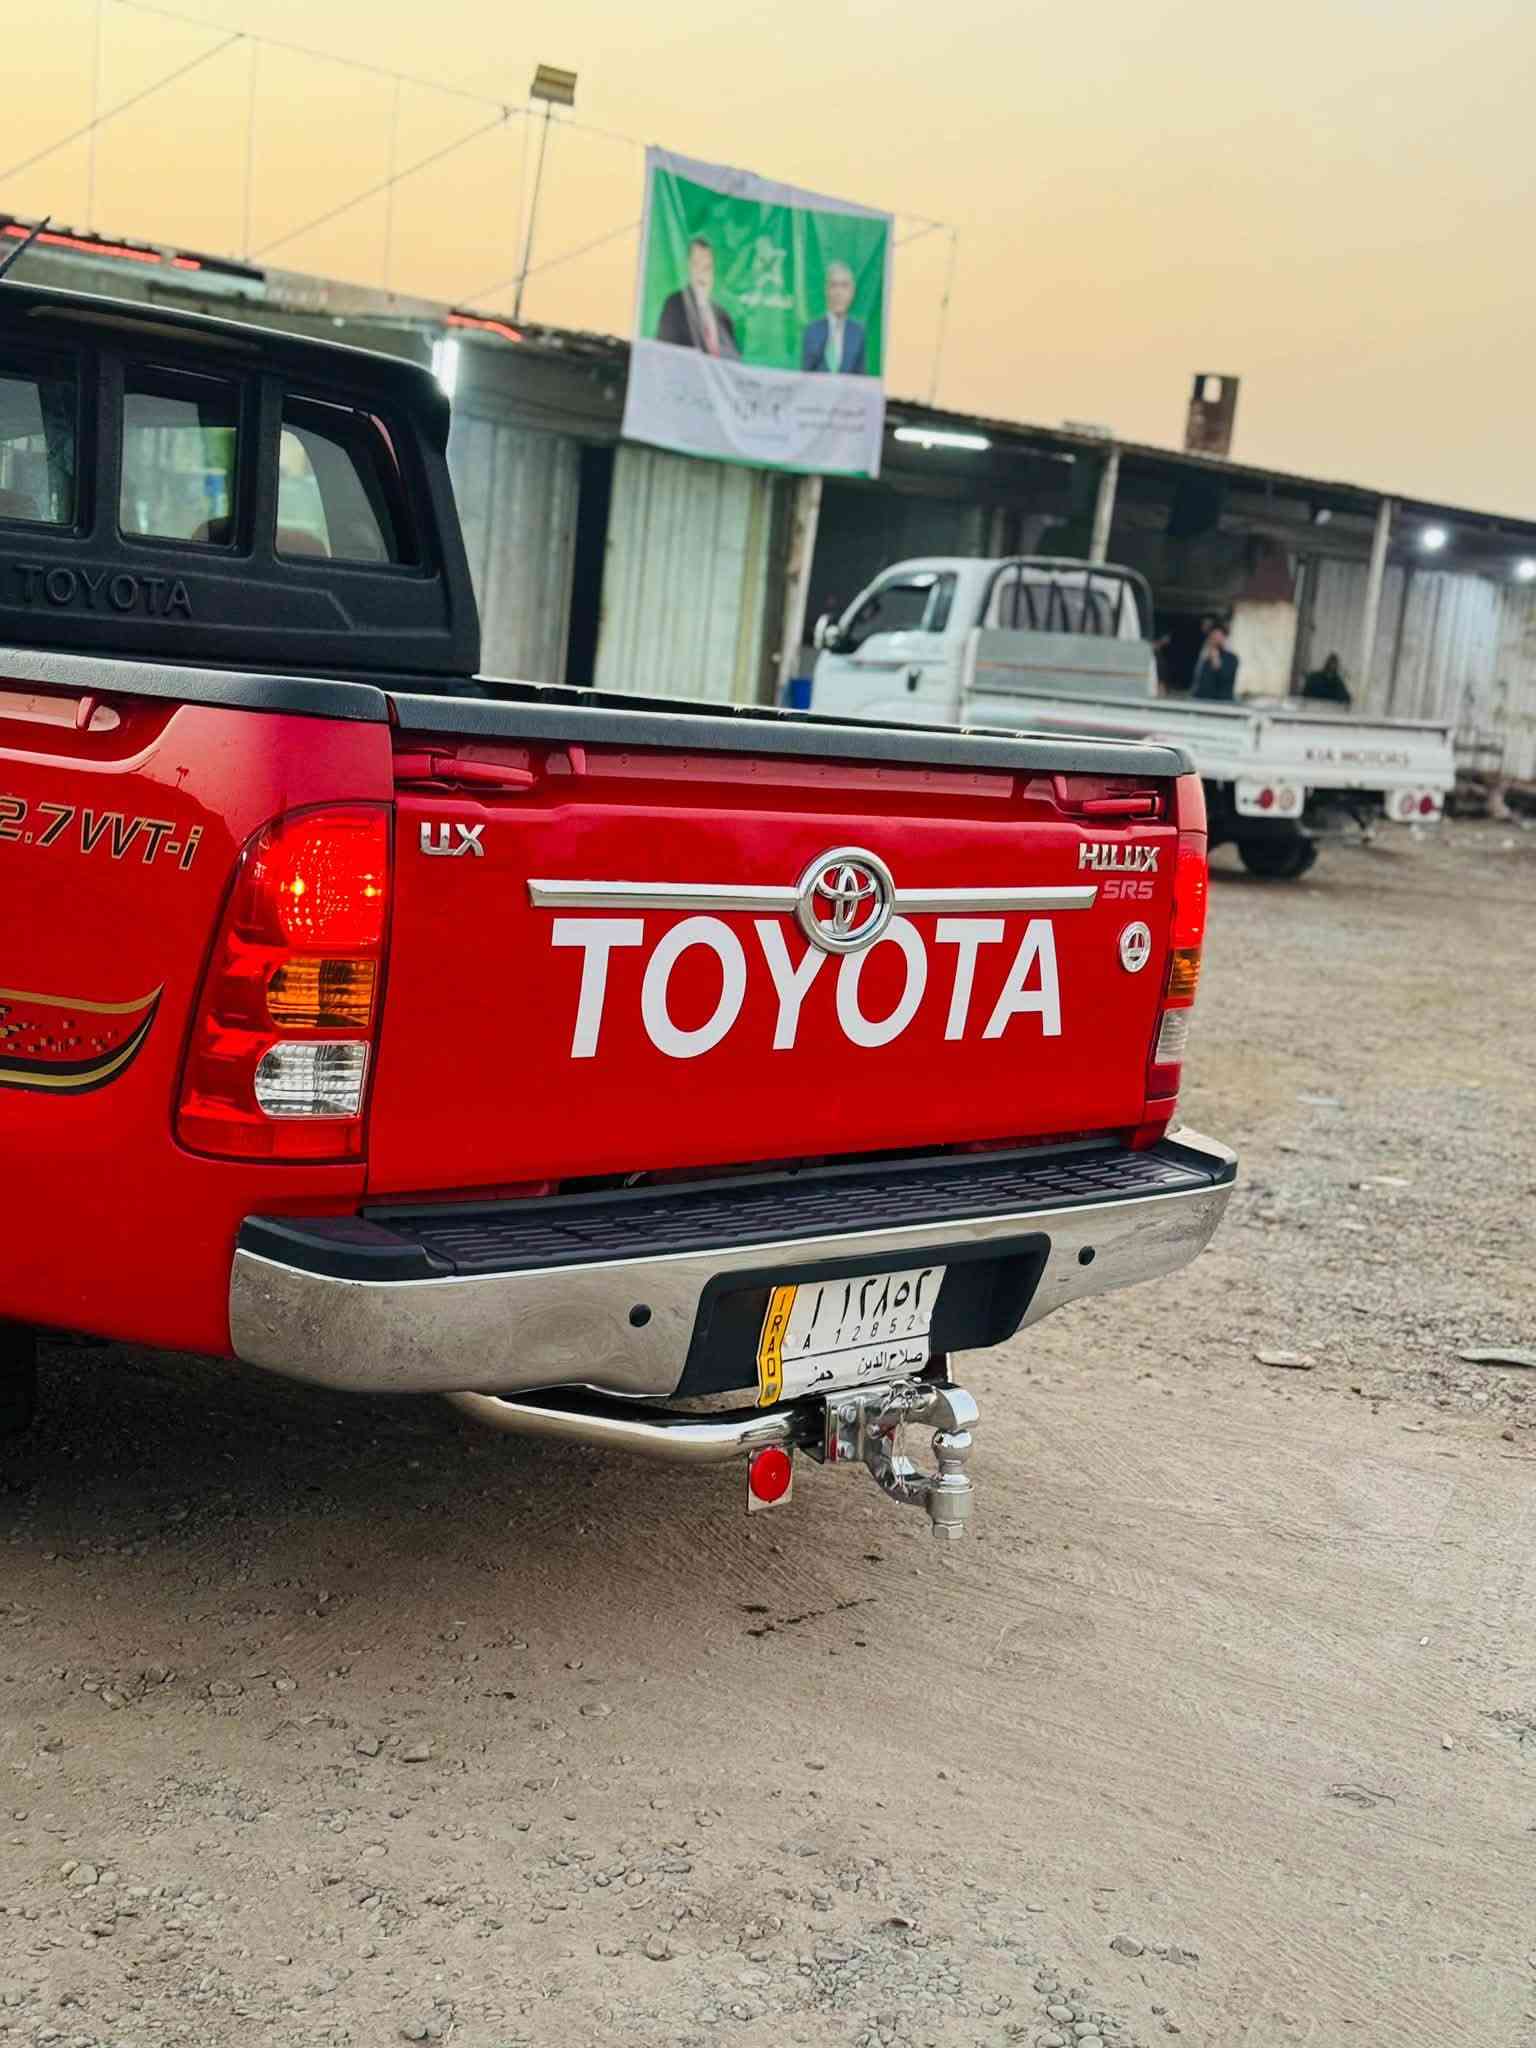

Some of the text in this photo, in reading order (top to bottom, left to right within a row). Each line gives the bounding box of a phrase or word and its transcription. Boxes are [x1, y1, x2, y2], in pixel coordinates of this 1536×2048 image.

[14, 563, 193, 618] TOYOTA
[1078, 843, 1161, 873] HILUX
[550, 914, 1063, 1060] TOYOTA
